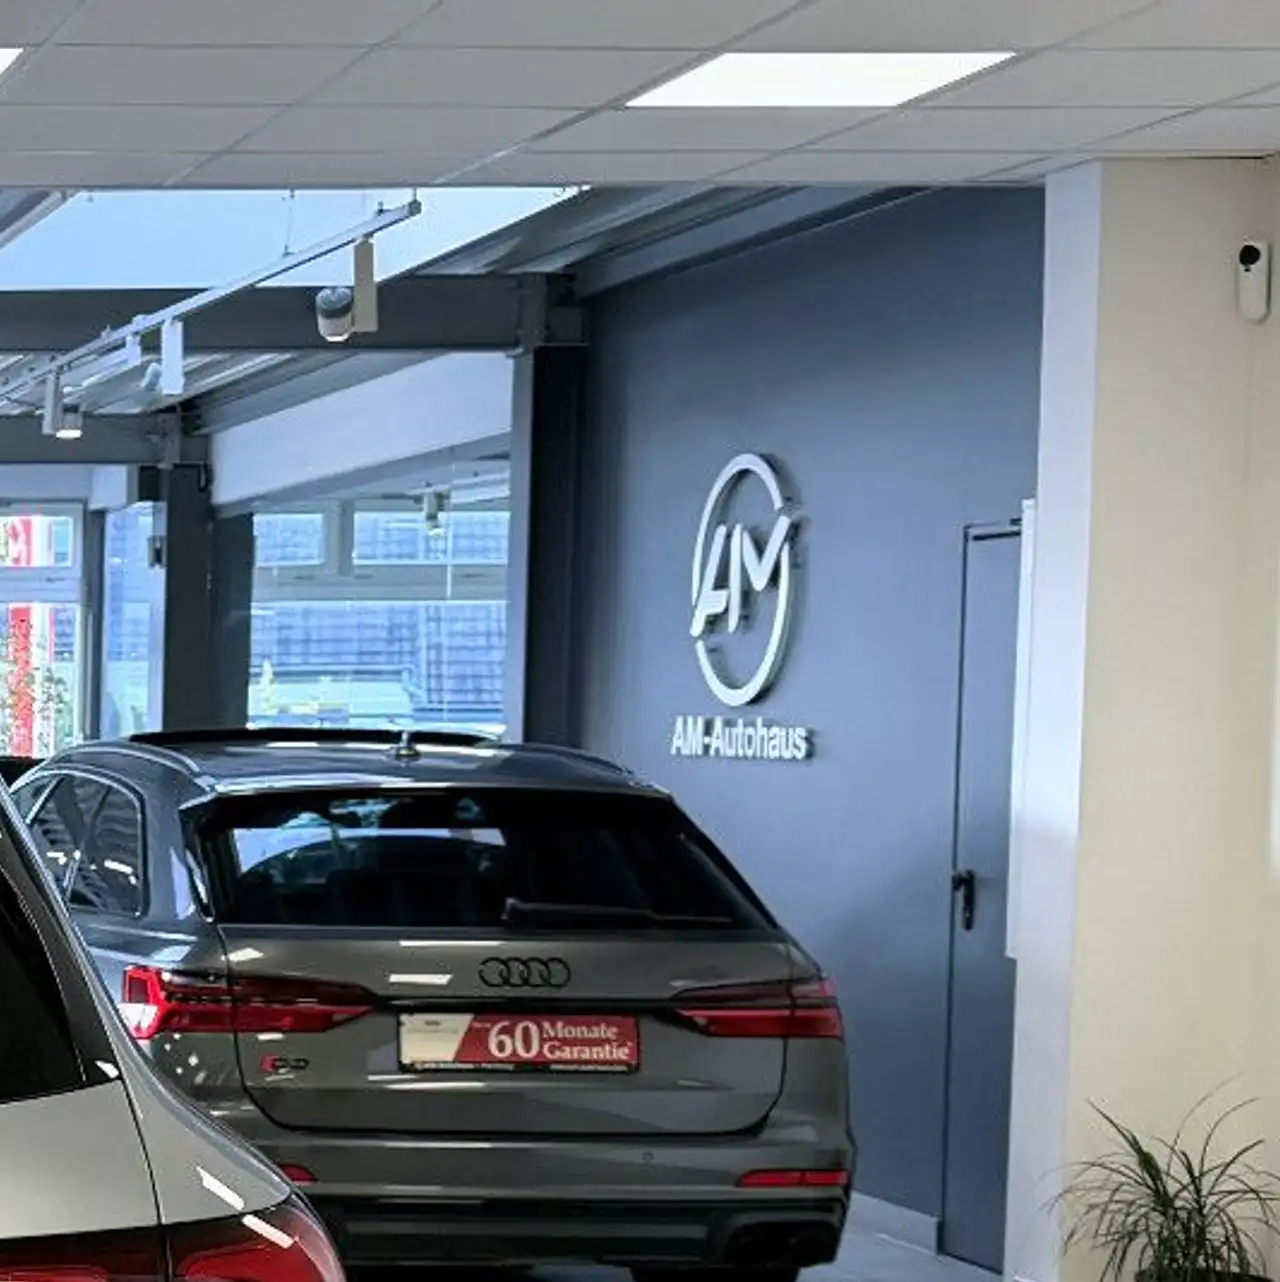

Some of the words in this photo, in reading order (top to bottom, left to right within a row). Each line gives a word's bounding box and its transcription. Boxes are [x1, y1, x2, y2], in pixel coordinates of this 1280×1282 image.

[670, 715, 808, 760] AM-Autohaus
[488, 1021, 538, 1058] 60
[542, 1022, 618, 1039] Monate
